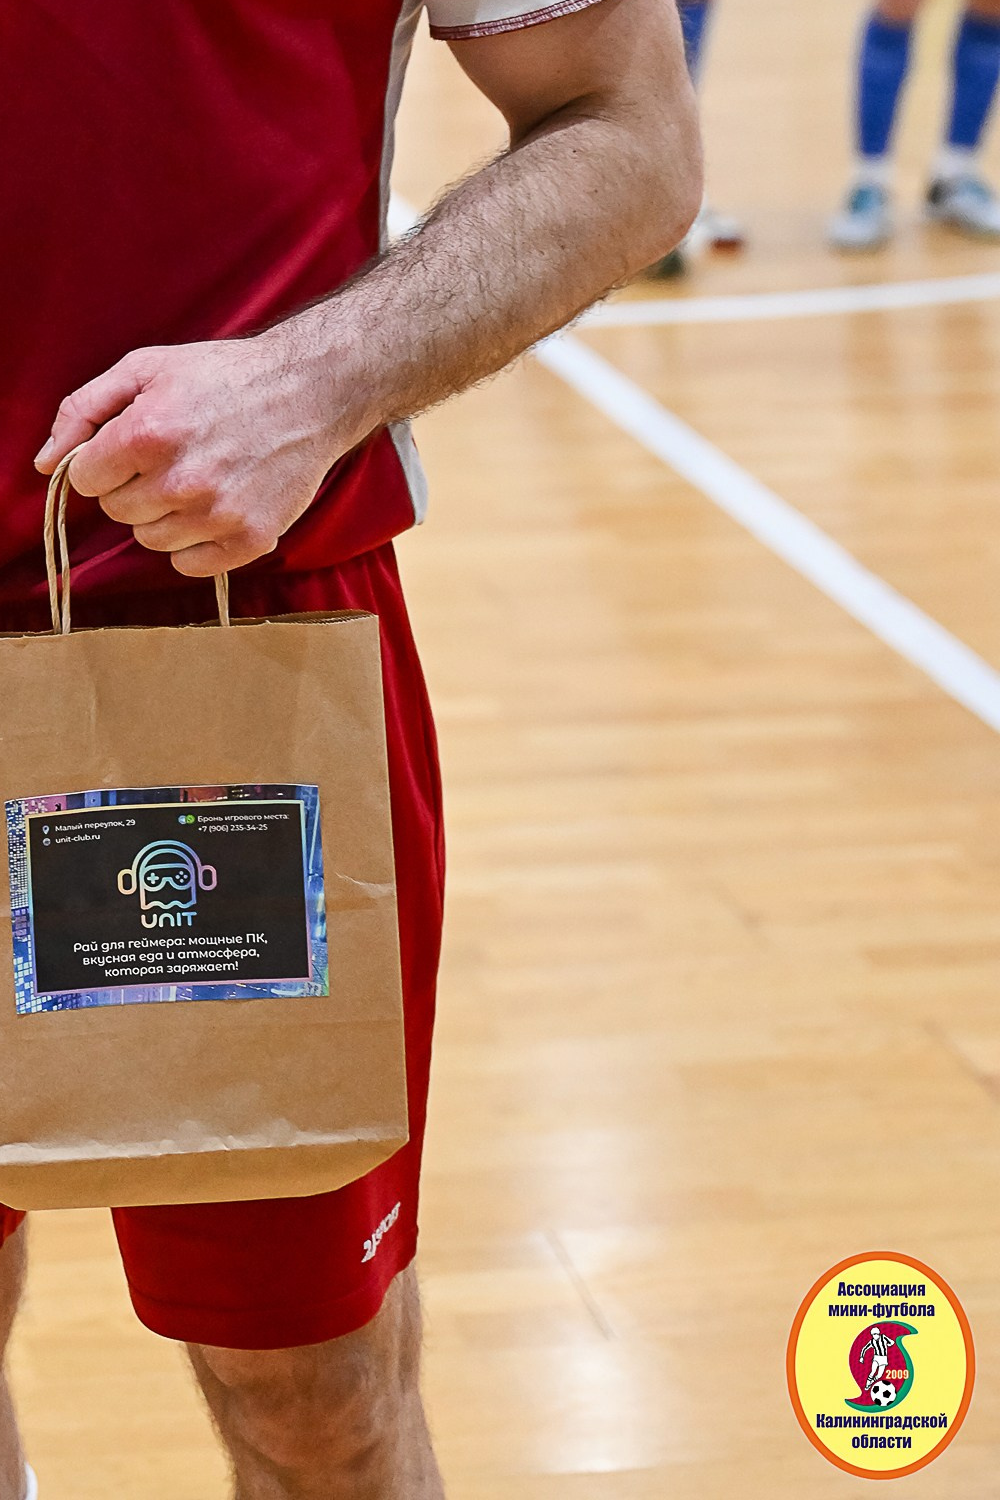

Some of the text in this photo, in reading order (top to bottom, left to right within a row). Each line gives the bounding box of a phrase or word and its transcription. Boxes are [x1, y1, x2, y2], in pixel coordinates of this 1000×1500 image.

[197, 815, 224, 823] Бронь
[224, 814, 263, 822] игрового
[55, 822, 83, 832] Малый
[84, 820, 125, 830] переулок,
[208, 824, 229, 833] (906)
[230, 823, 268, 832] 235-34-25
[55, 833, 101, 844] unit-club.ru
[73, 932, 268, 953] Рай для геймера: мощные ПК,
[82, 947, 260, 967] вкусная еда и атмосфера,
[104, 960, 239, 977] которая заряжает!
